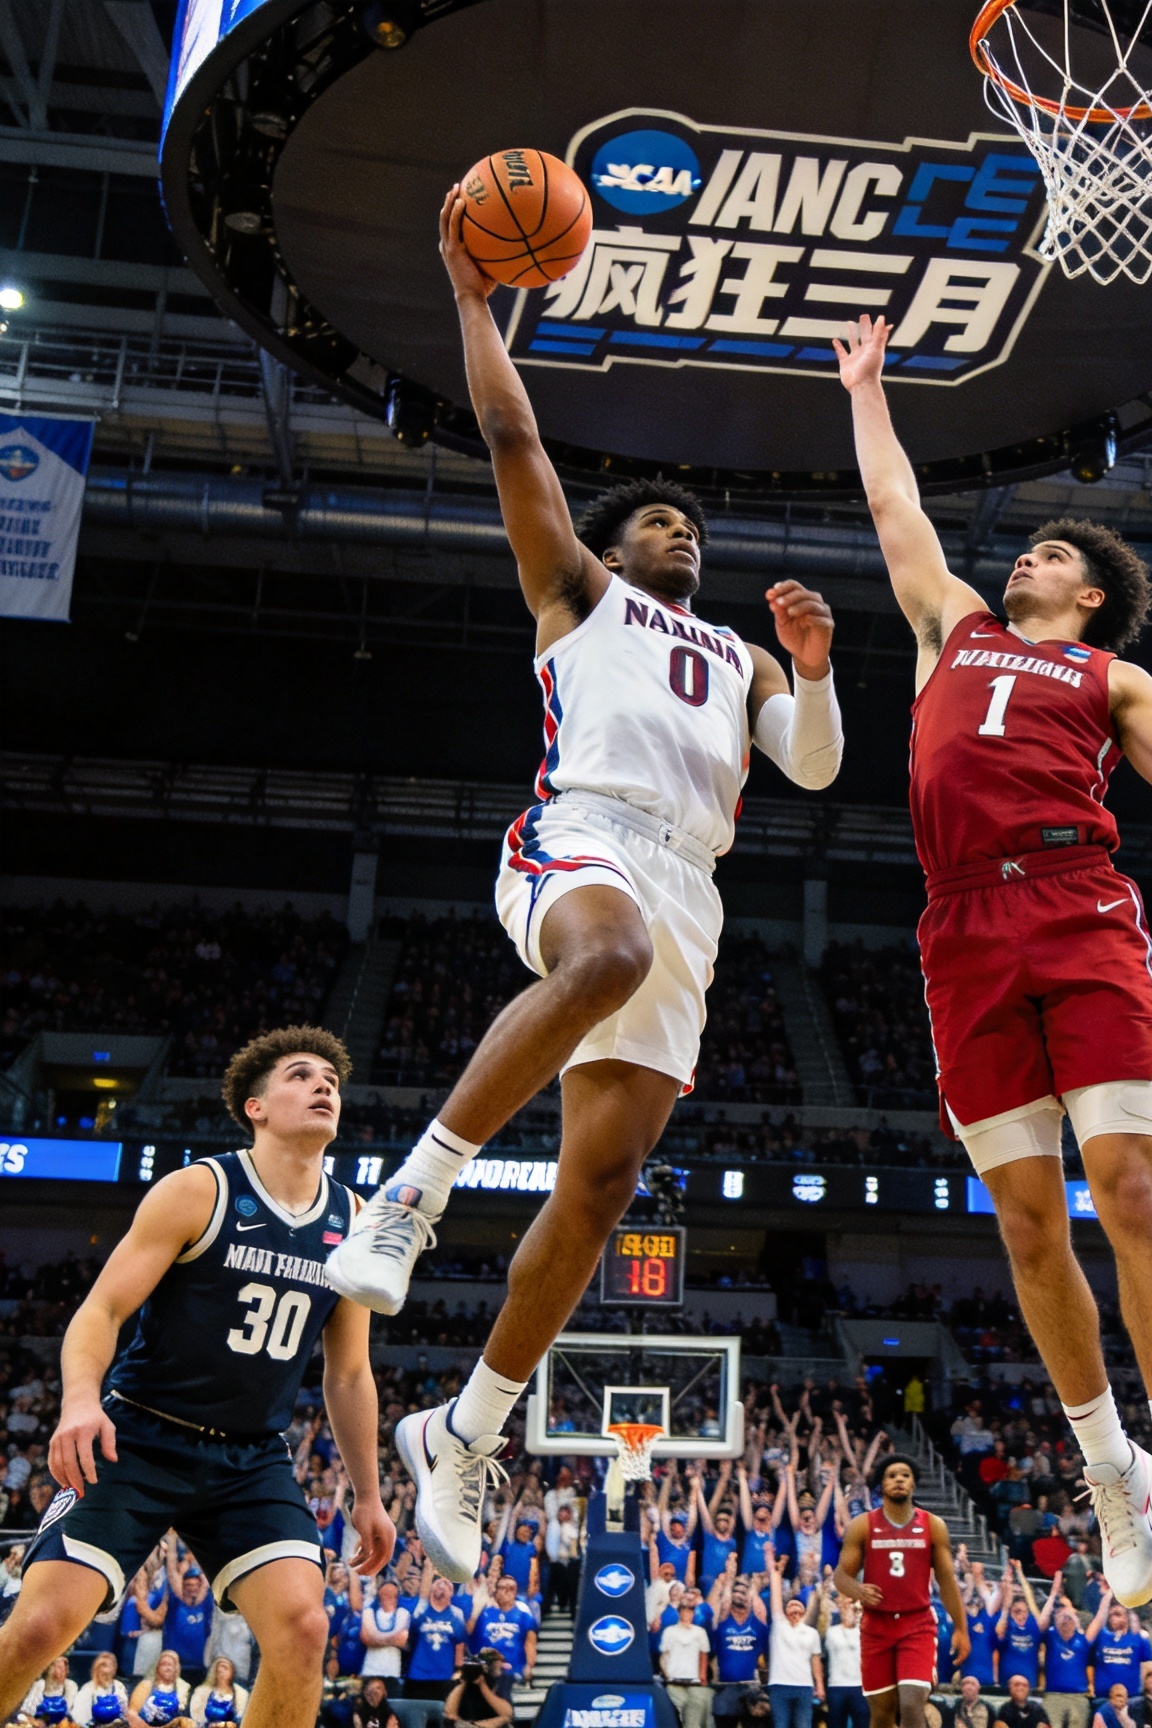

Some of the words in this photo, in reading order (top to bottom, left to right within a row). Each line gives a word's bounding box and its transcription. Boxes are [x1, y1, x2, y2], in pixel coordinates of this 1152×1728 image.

[544, 225, 1021, 353] 疯狂三月
[669, 645, 709, 707] 0
[978, 675, 1017, 737] 1
[0, 1143, 28, 1174] S
[226, 1282, 312, 1361] 30
